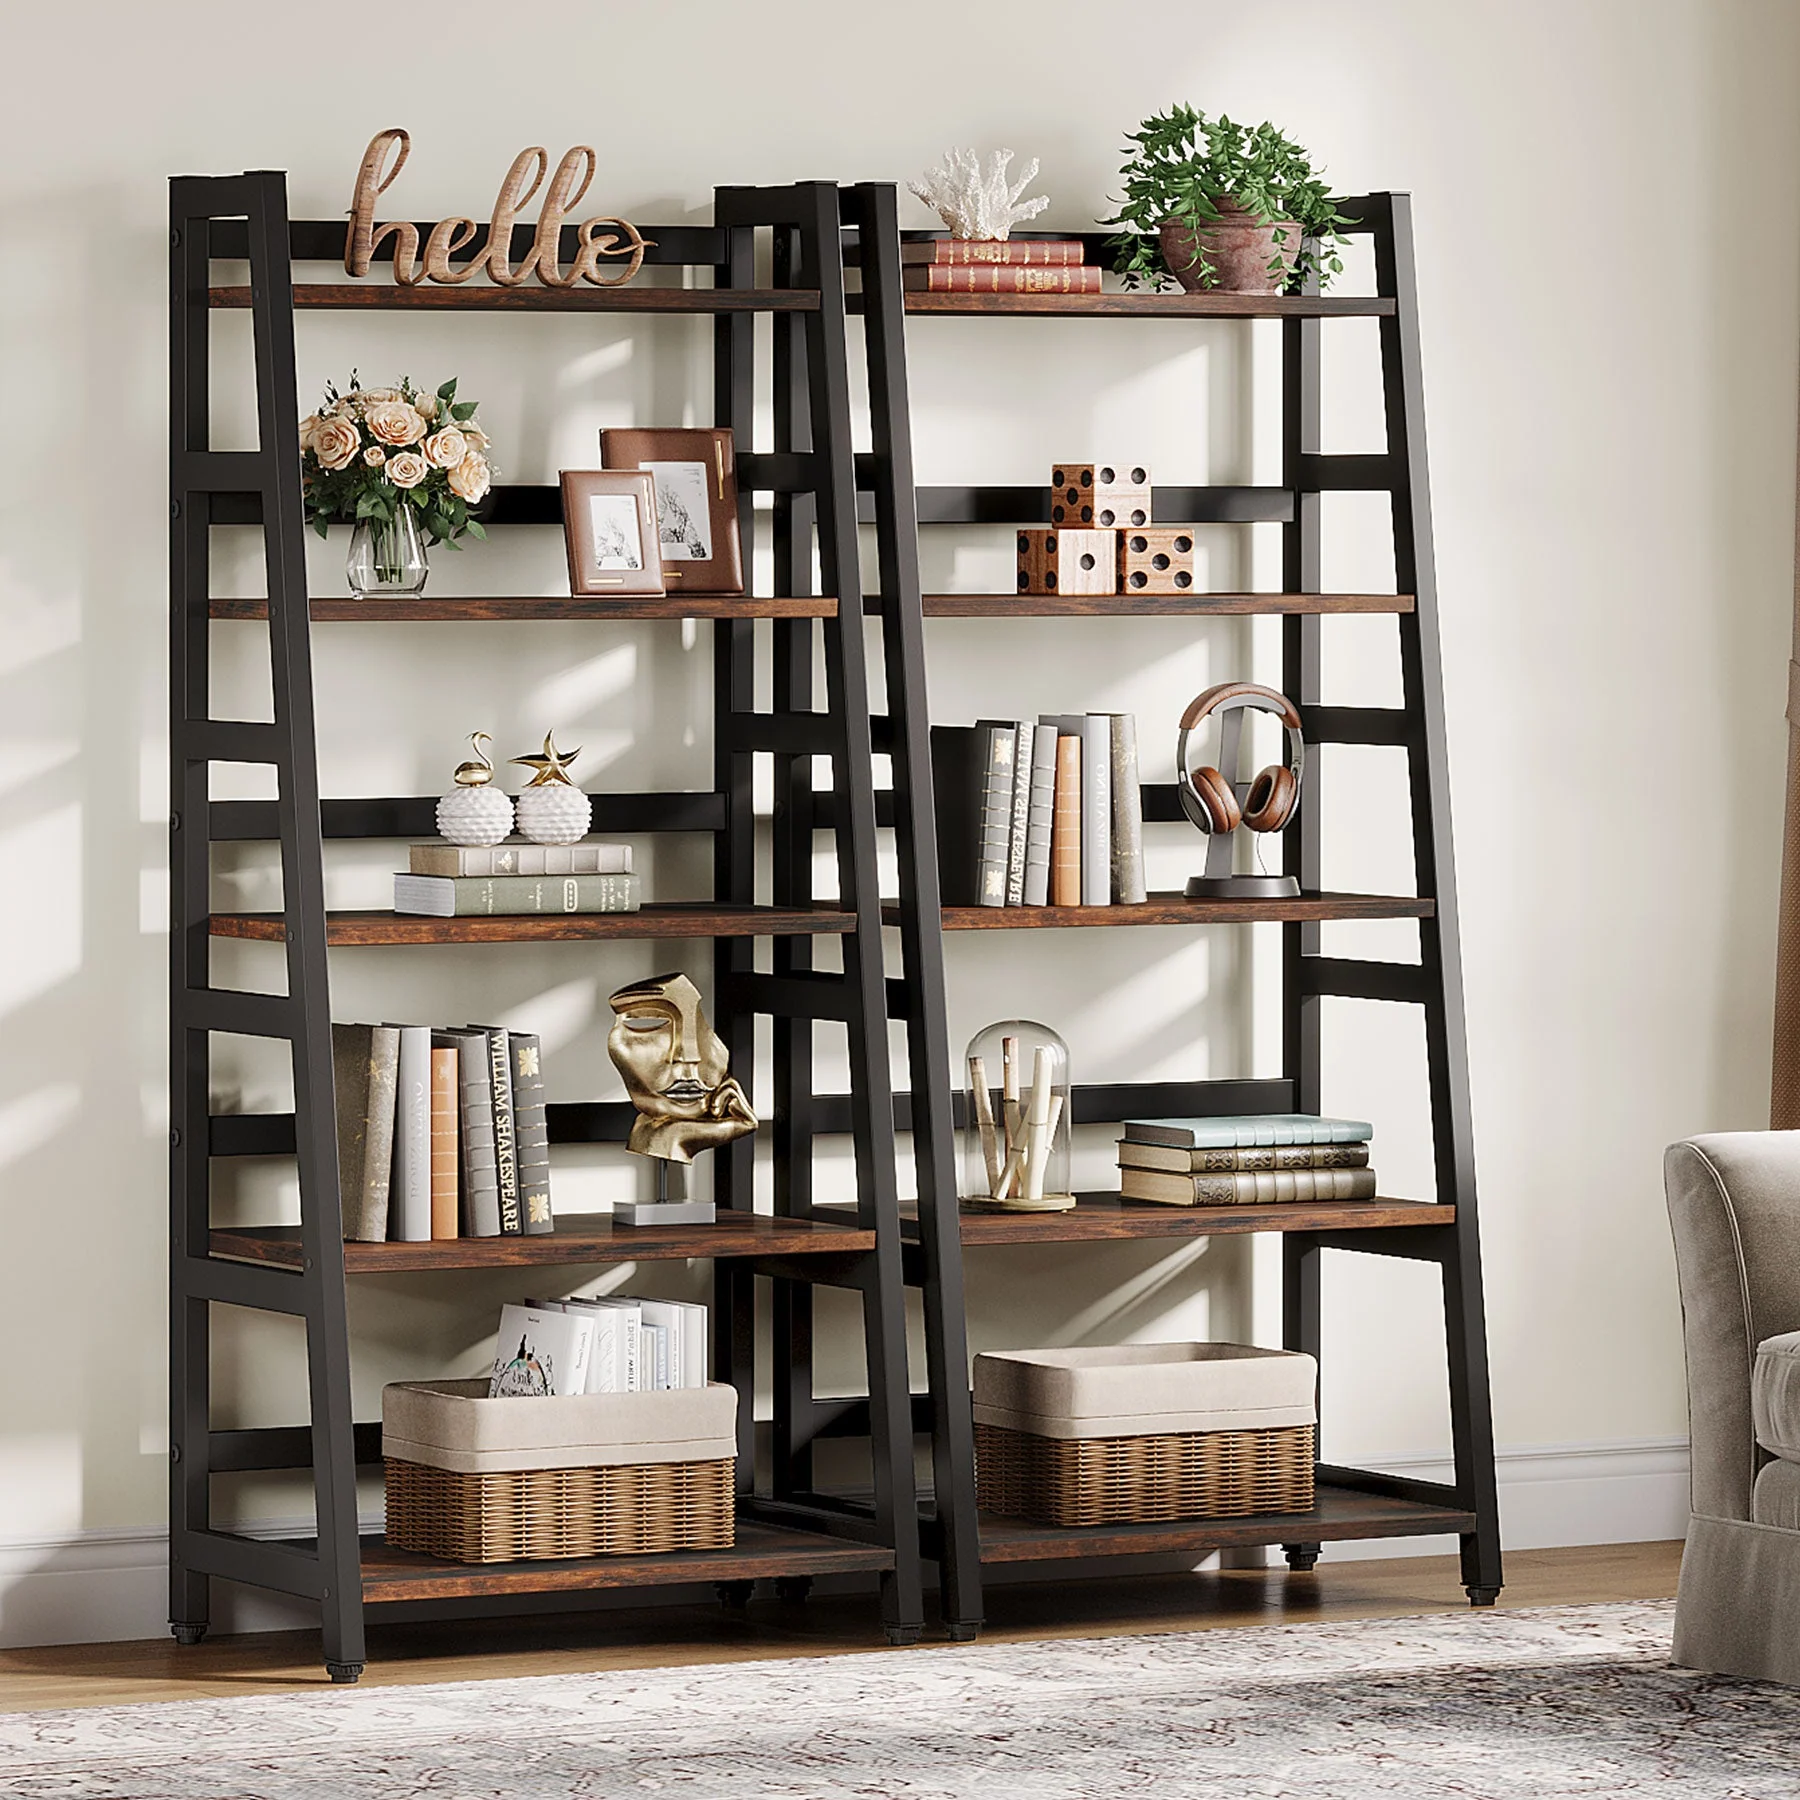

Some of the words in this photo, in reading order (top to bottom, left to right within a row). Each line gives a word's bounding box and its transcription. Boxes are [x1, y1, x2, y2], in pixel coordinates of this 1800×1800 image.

[344, 128, 657, 288] hello
[491, 1033, 505, 1112] WILLIAM
[496, 1114, 519, 1232] SHAKESPEARE
